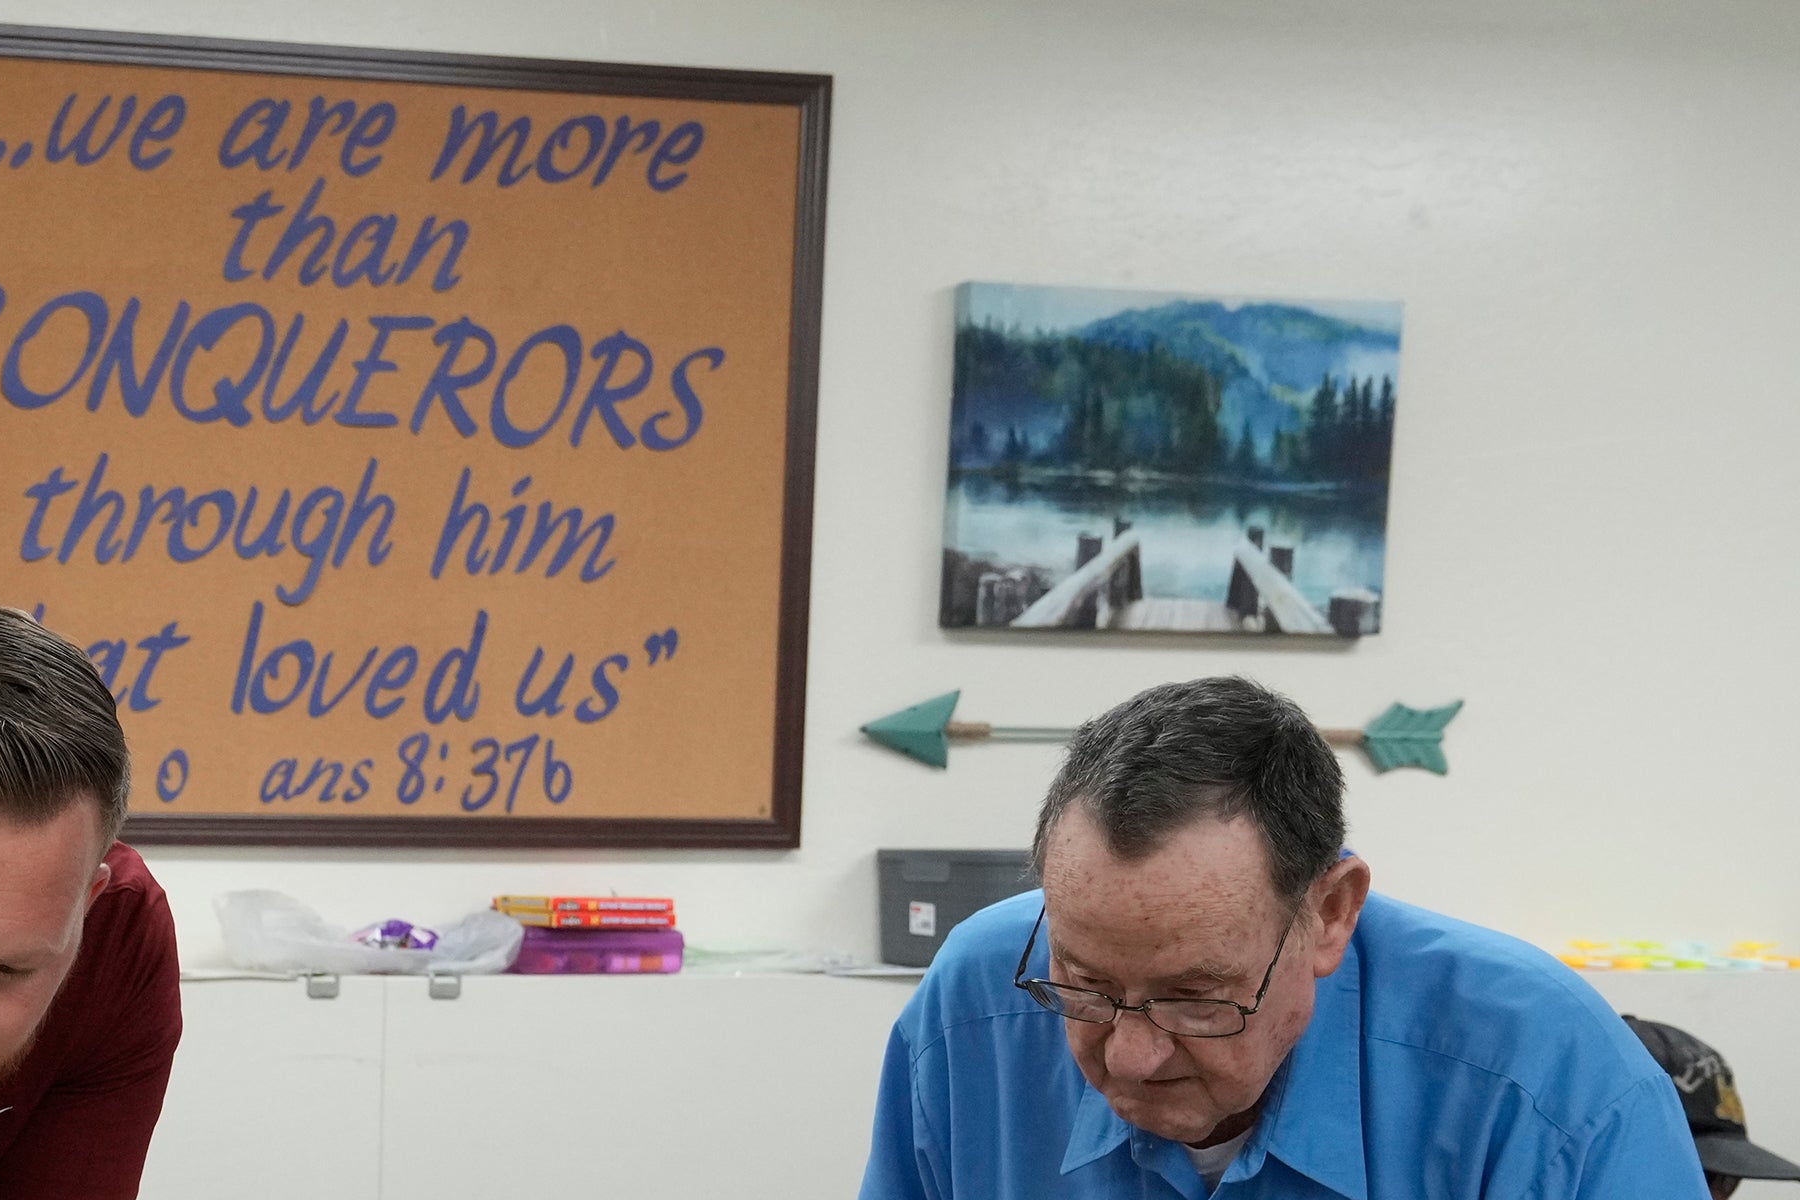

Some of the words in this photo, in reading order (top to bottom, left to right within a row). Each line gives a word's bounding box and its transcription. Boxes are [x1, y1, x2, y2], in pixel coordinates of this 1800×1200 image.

[219, 96, 396, 176] are
[432, 105, 704, 191] more
[223, 178, 469, 291] than
[20, 453, 395, 605] through
[431, 467, 615, 581] him
[231, 601, 488, 724] loved
